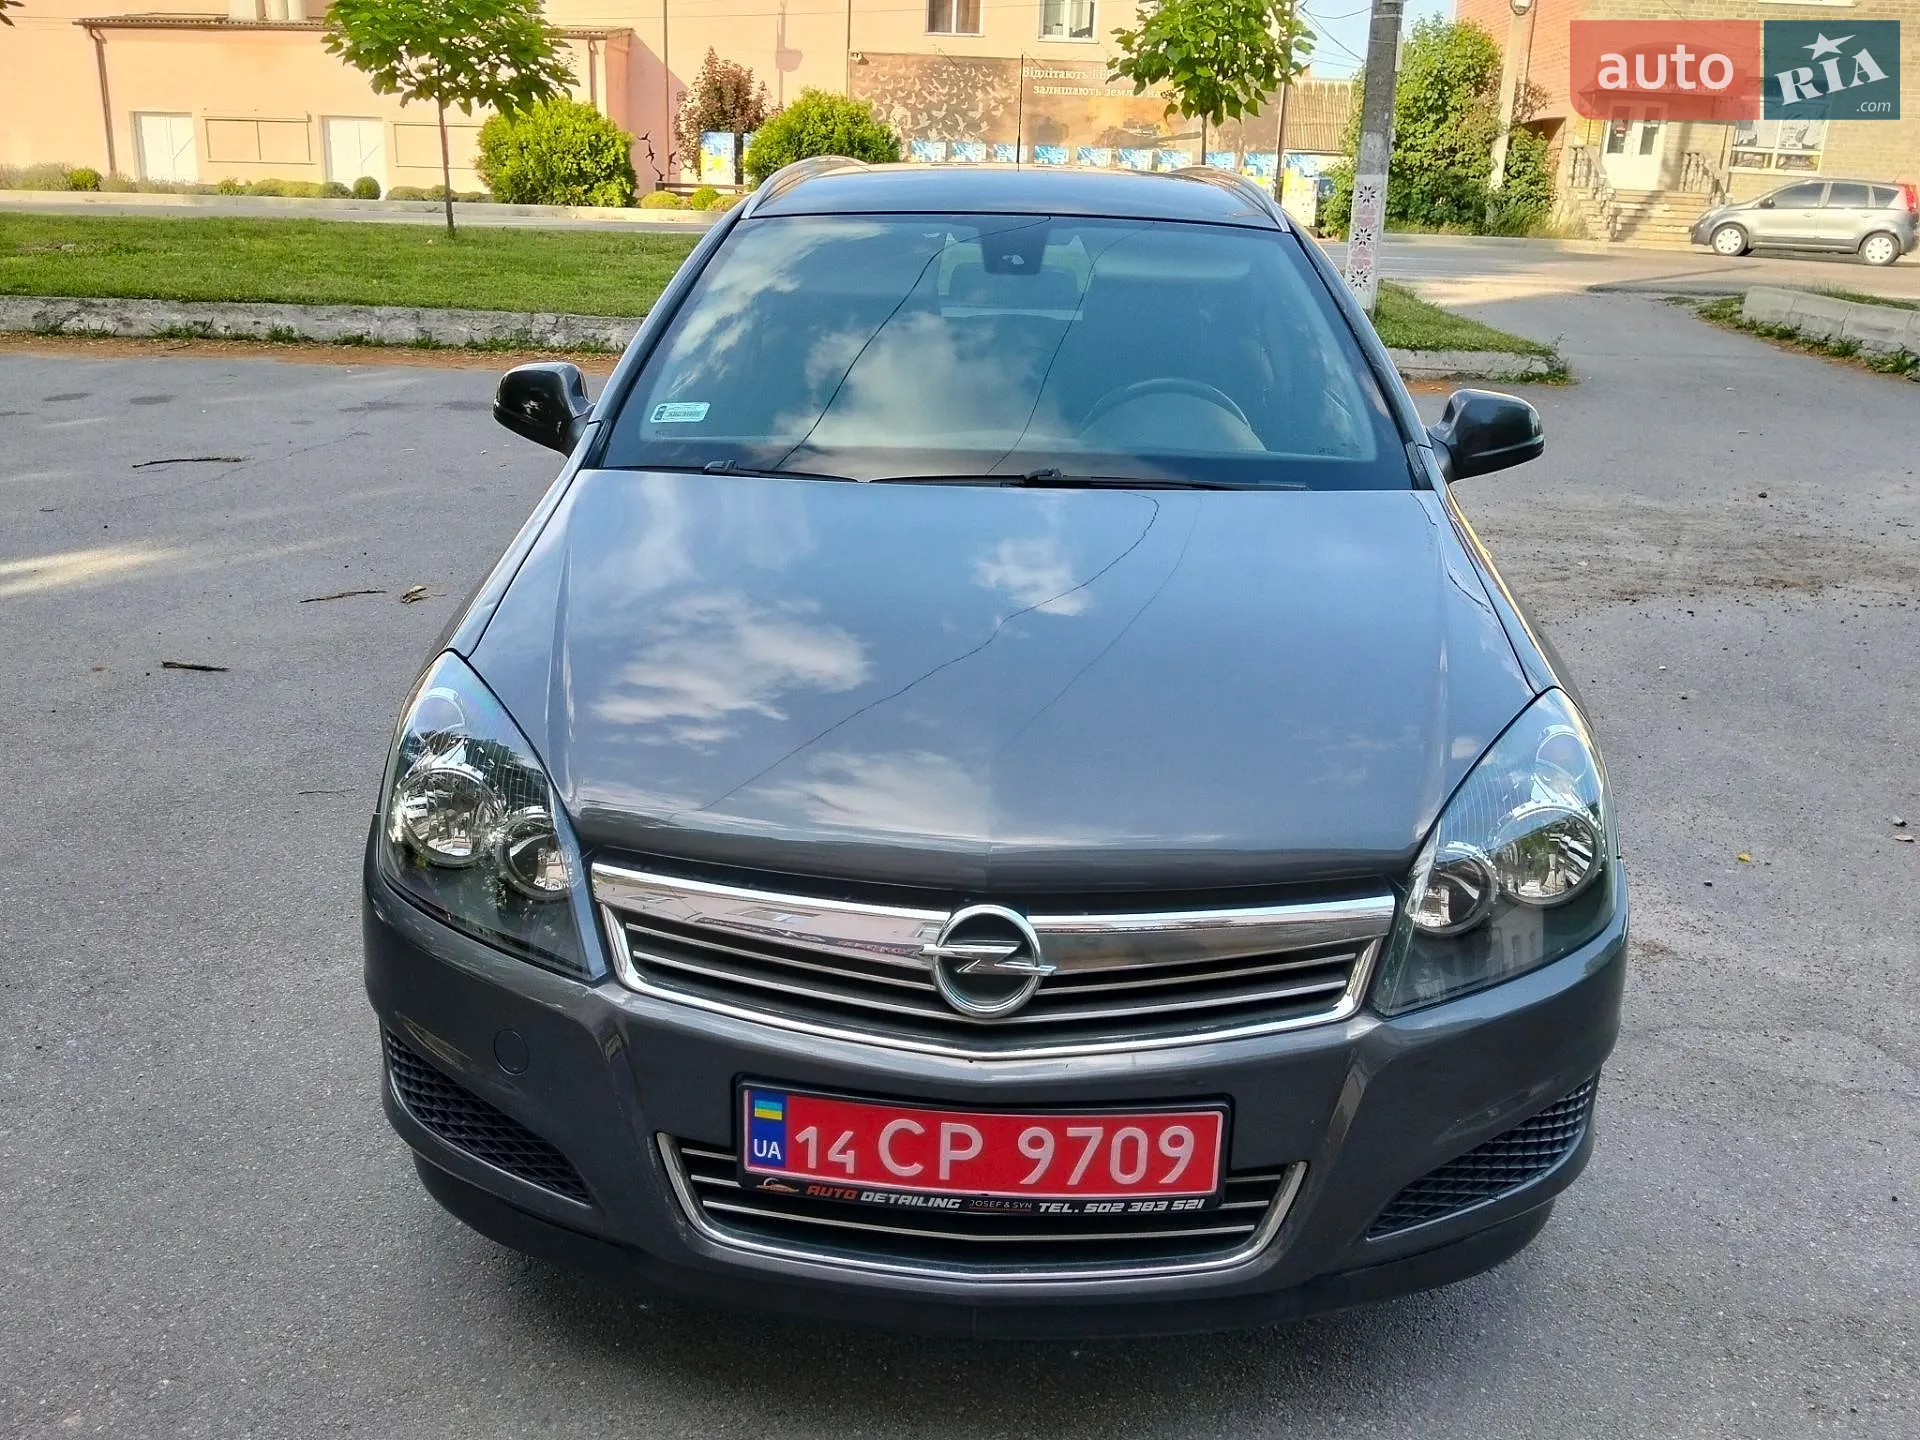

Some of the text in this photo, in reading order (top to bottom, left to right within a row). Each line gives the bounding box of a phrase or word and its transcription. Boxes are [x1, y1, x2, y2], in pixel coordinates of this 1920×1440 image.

[1022, 66, 1089, 81] Відлітають
[1032, 84, 1102, 97] залишають
[753, 1138, 782, 1160] UA
[795, 1118, 1195, 1185] 14 CP 9709
[807, 1185, 1206, 1214] AUTO DETAILING JOSEF & SYN TEL. 502 383 521
